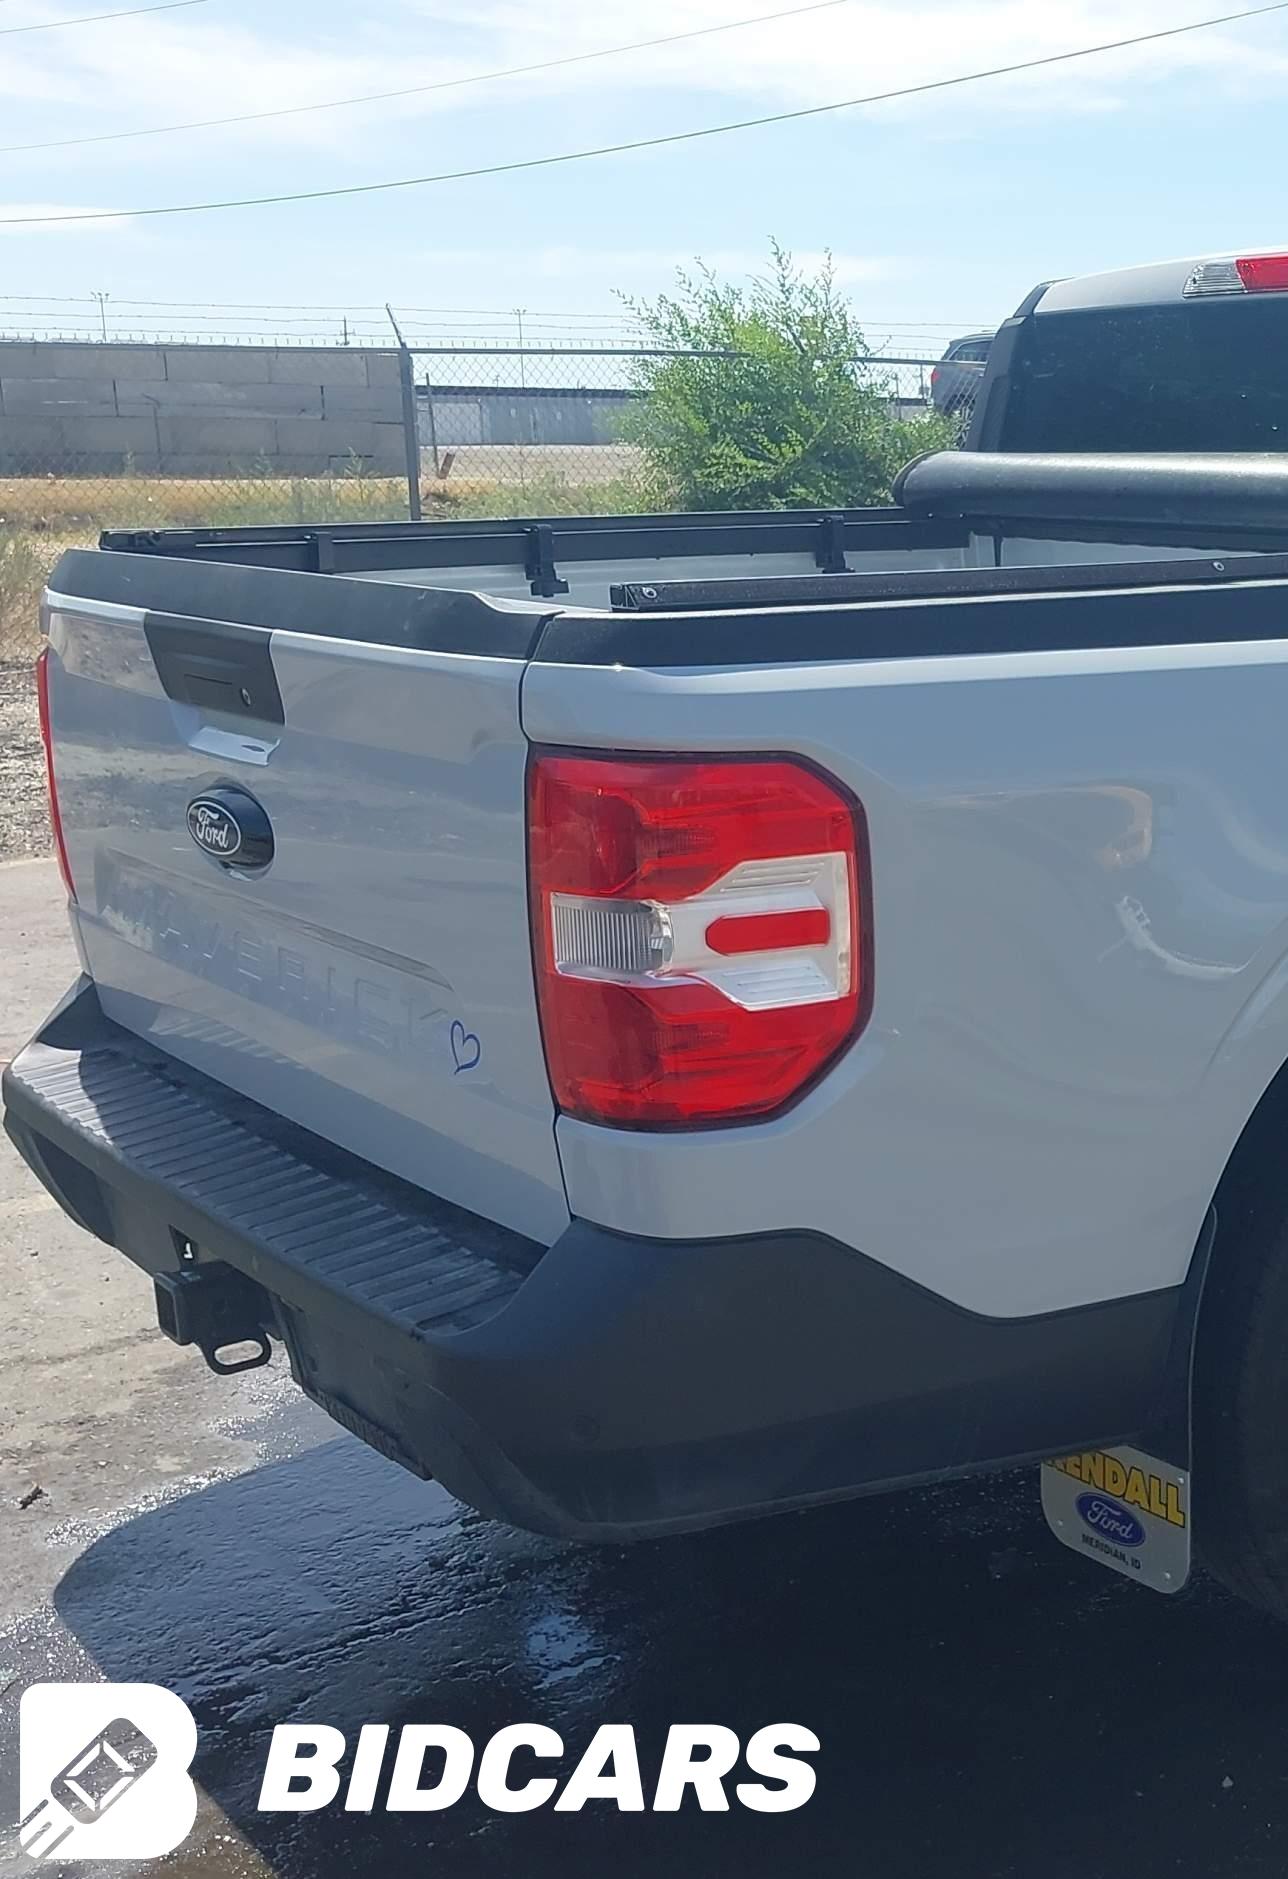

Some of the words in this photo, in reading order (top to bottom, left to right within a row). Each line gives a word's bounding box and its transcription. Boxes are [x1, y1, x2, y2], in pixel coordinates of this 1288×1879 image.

[196, 806, 229, 849] Ford
[1044, 1450, 1186, 1529] ENDALL
[1086, 1500, 1134, 1540] Ford
